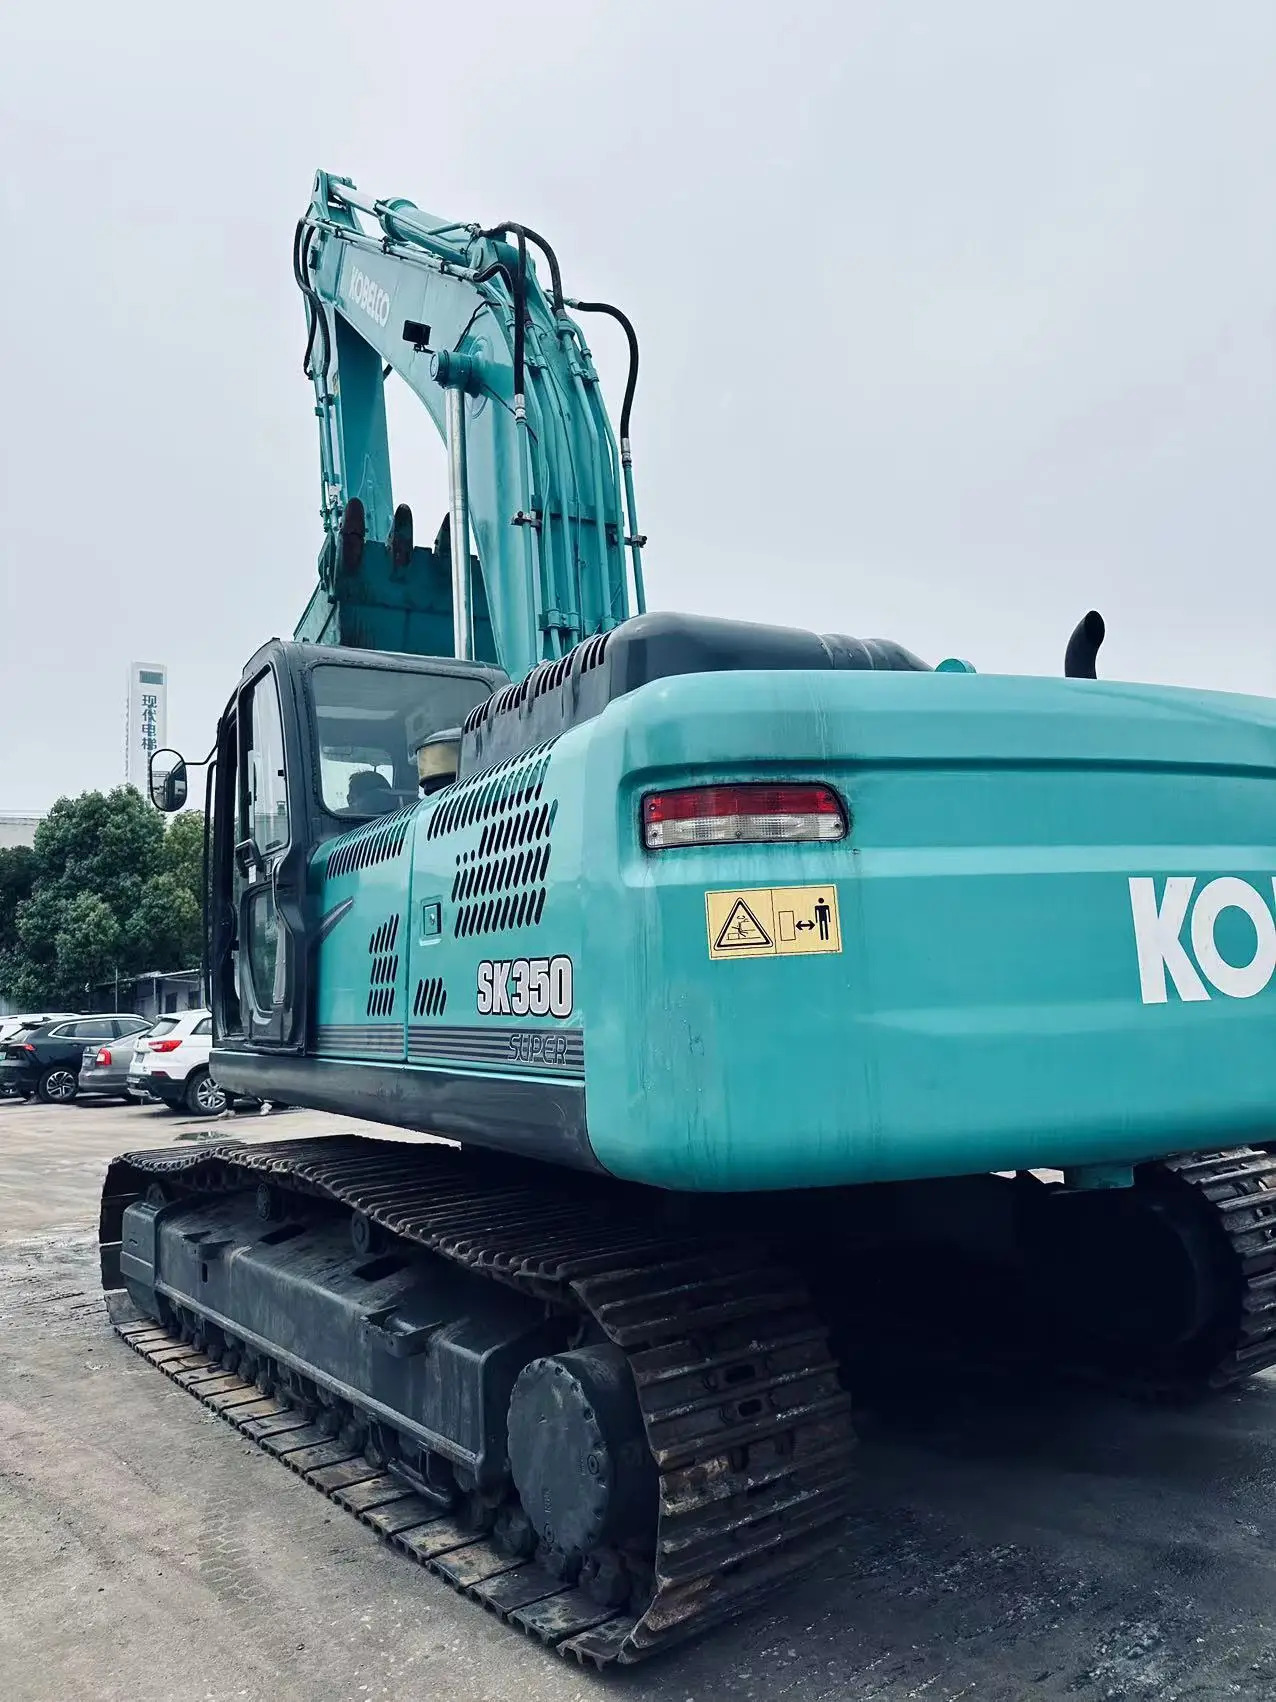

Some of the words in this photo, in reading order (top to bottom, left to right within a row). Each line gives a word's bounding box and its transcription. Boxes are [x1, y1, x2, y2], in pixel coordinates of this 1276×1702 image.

[348, 265, 390, 328] KOBELCO
[141, 694, 158, 751] 现代电梯
[1128, 876, 1276, 1005] KO
[477, 954, 573, 1019] SK350
[508, 1034, 568, 1065] SUPER
